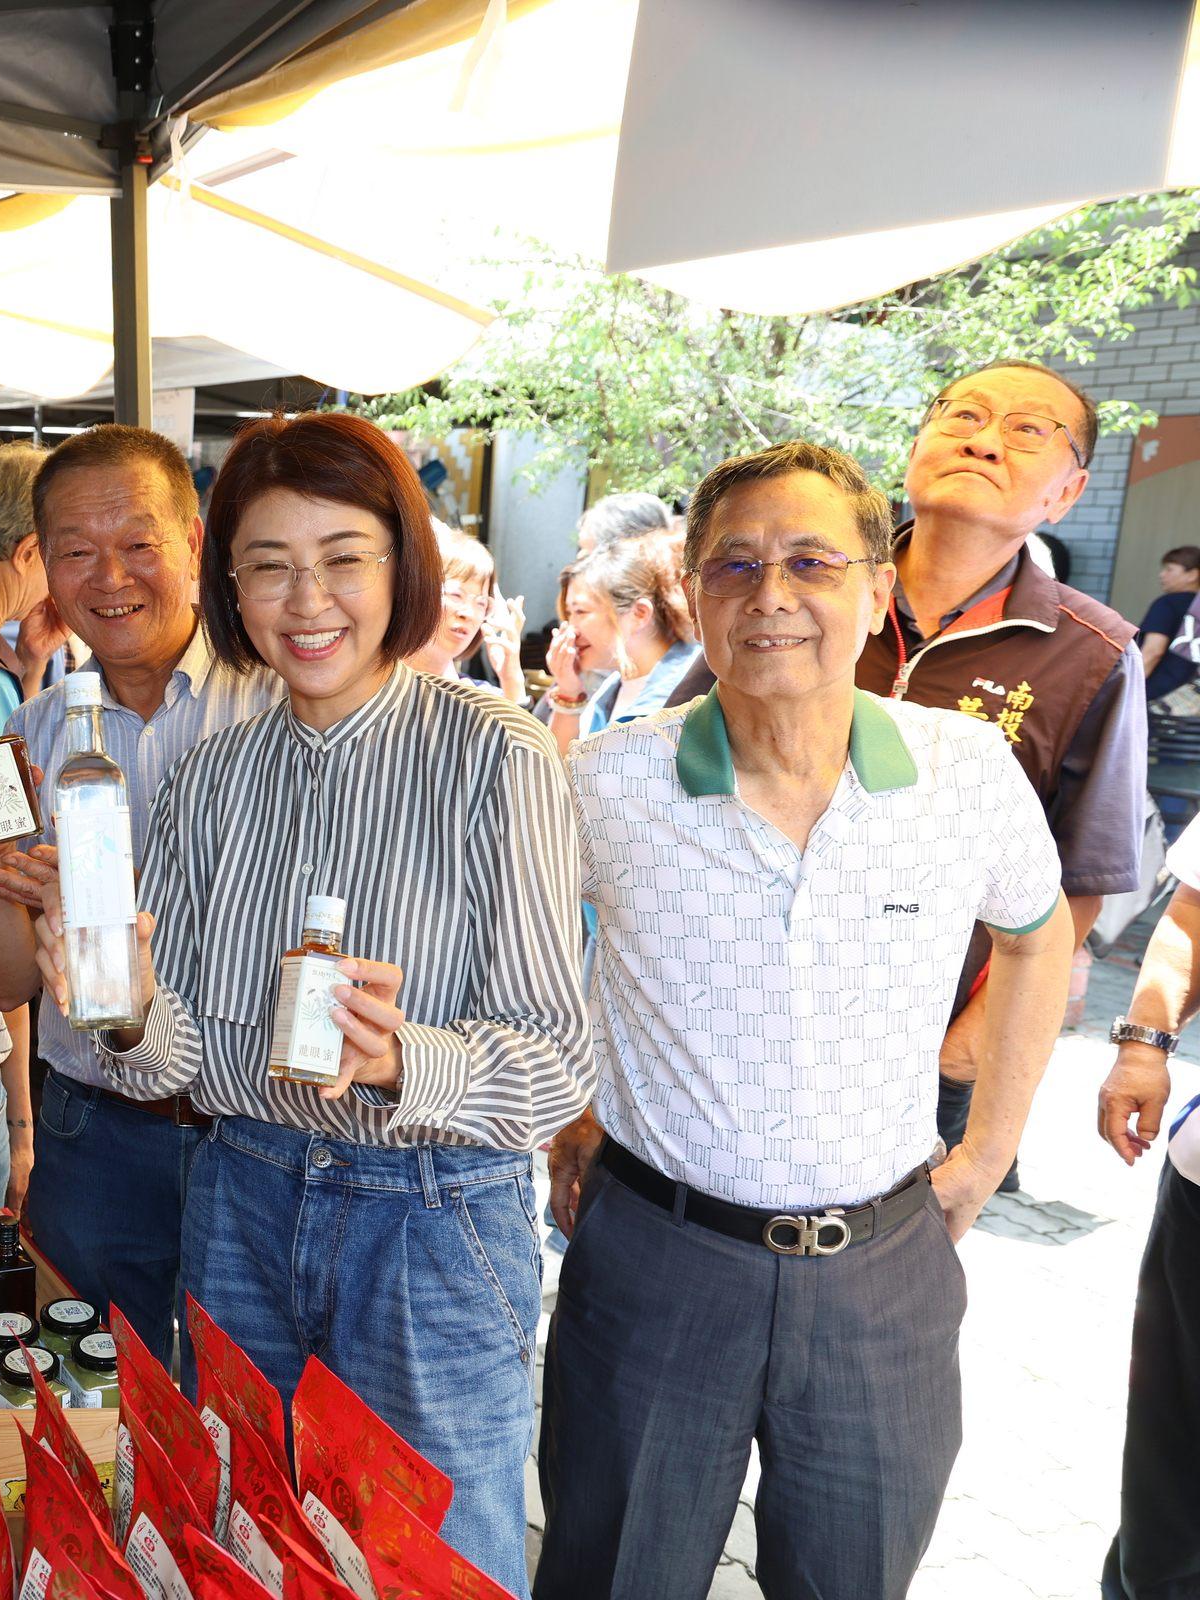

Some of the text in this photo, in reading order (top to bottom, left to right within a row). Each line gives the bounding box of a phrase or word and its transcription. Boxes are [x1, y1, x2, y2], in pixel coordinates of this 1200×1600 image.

[972, 677, 1006, 695] FILA
[996, 680, 1035, 745] 南投
[884, 904, 919, 913] PING
[298, 1044, 335, 1062] 龍眼蜜
